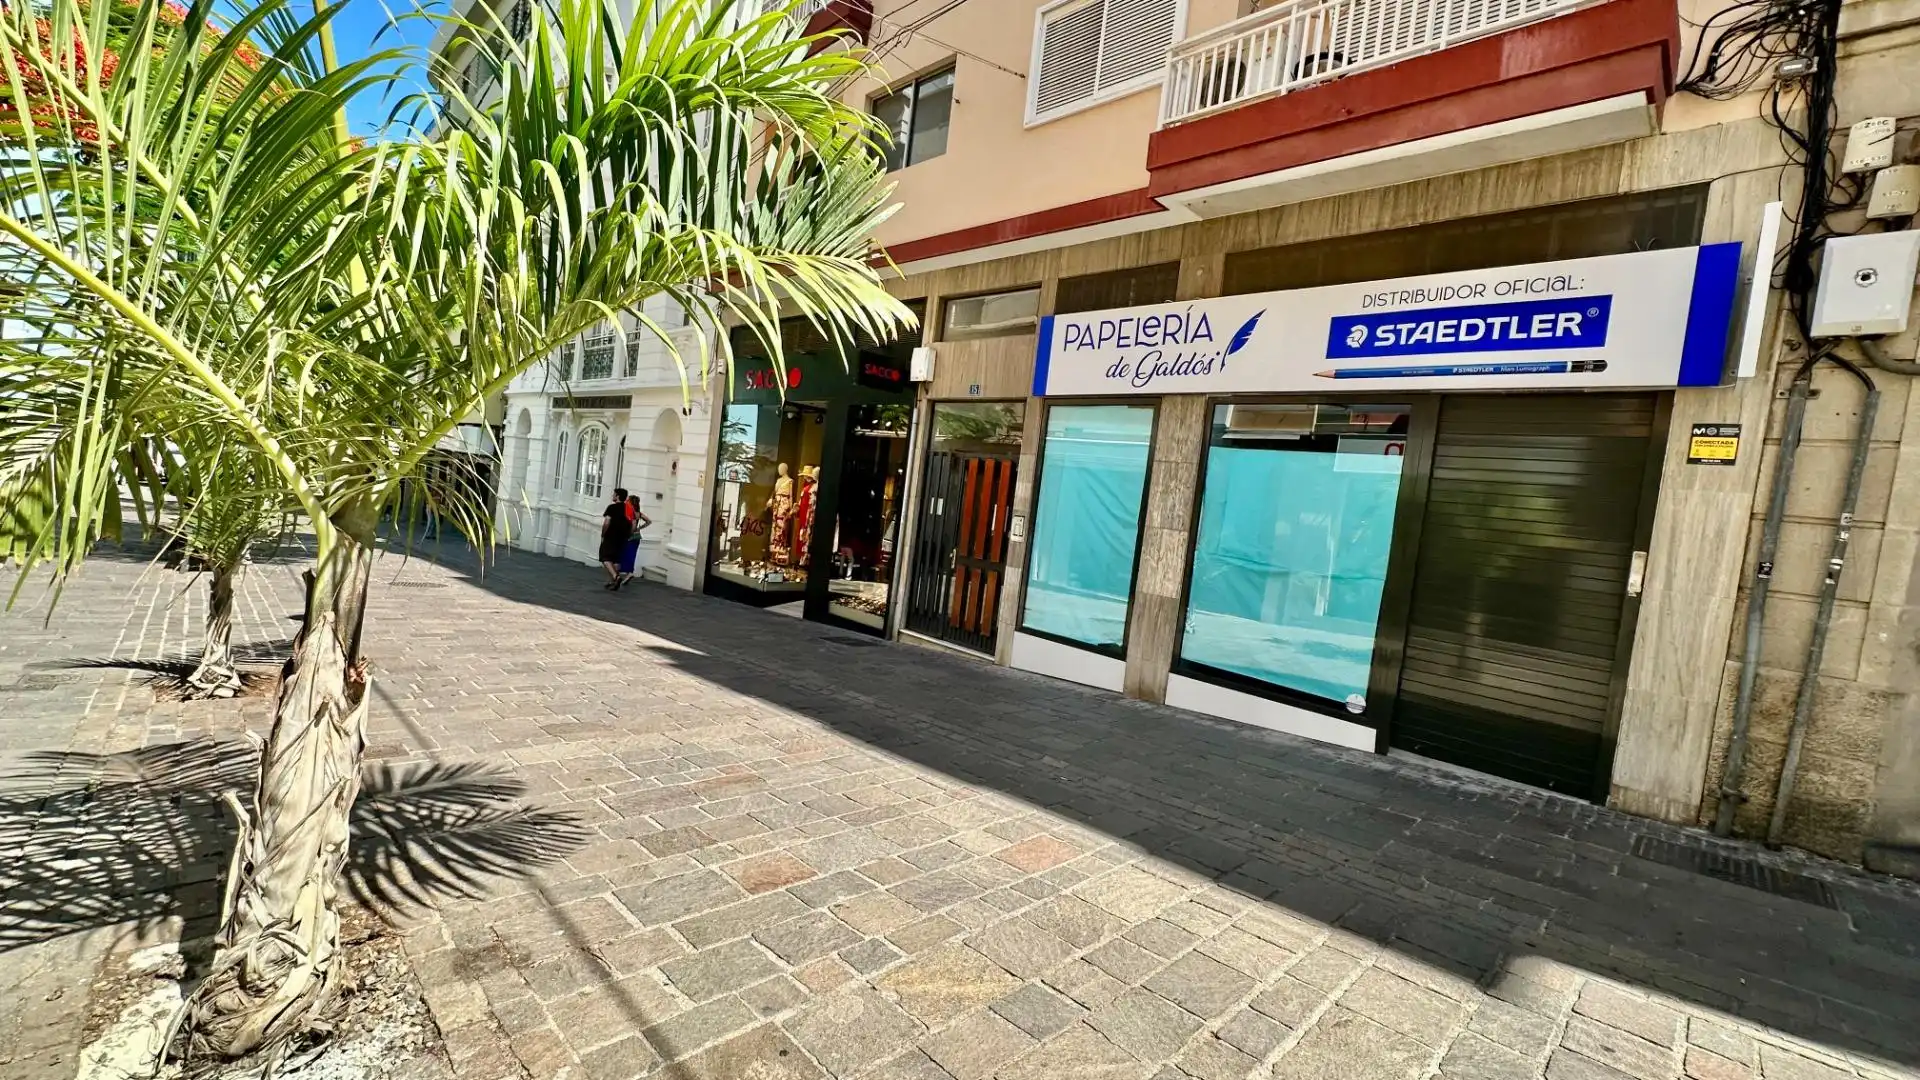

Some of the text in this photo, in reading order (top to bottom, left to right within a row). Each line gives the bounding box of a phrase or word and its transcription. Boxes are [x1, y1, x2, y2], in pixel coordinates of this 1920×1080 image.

[1362, 283, 1485, 308] DISTRIBUIDOR
[744, 367, 802, 390] SACO
[864, 363, 900, 382] SACCO
[1106, 350, 1216, 388] de Galdós
